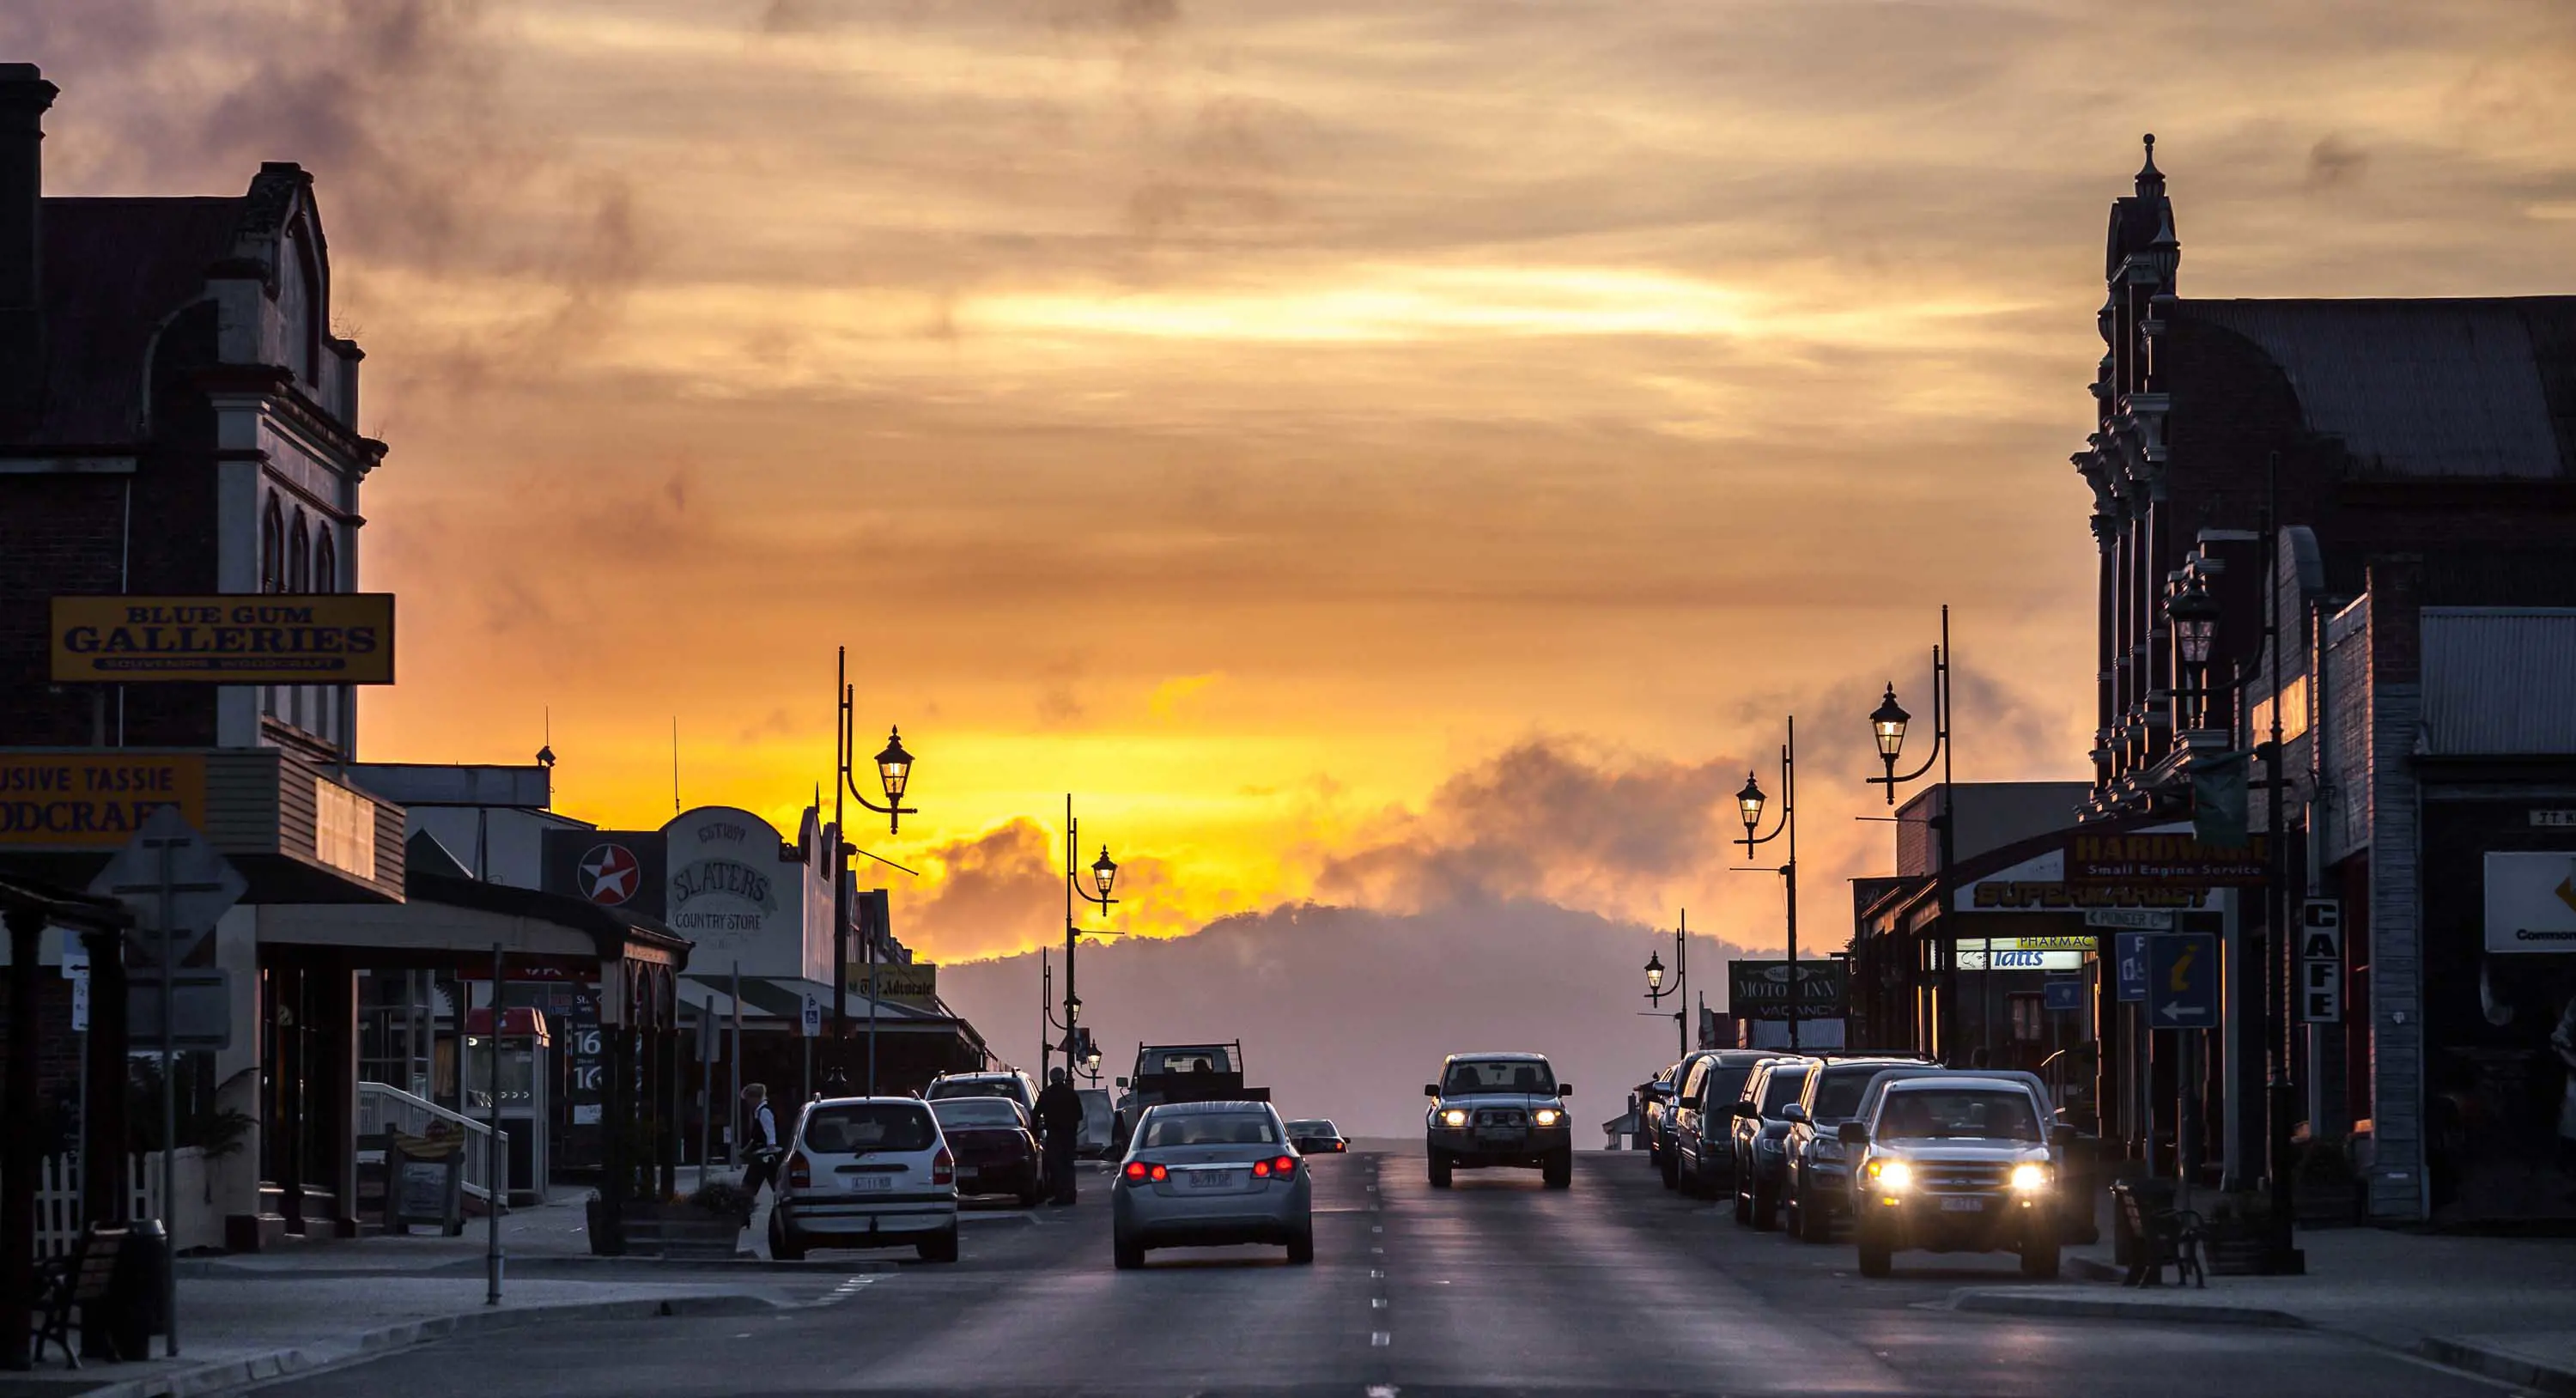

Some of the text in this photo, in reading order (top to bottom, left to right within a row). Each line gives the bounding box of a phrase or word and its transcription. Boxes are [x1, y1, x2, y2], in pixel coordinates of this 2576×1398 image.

[126, 606, 313, 623] BLUE GUM
[64, 626, 376, 653] GALLERIES
[84, 767, 174, 791] TASSIE
[2088, 864, 2262, 878] Small Engine Service
[673, 862, 769, 902] SLATERS
[676, 913, 762, 932] COUNTRY STORE
[2020, 935, 2097, 947] PHARMAC
[2305, 904, 2337, 1017] CAFE
[1739, 980, 1836, 997] MOTO INN
